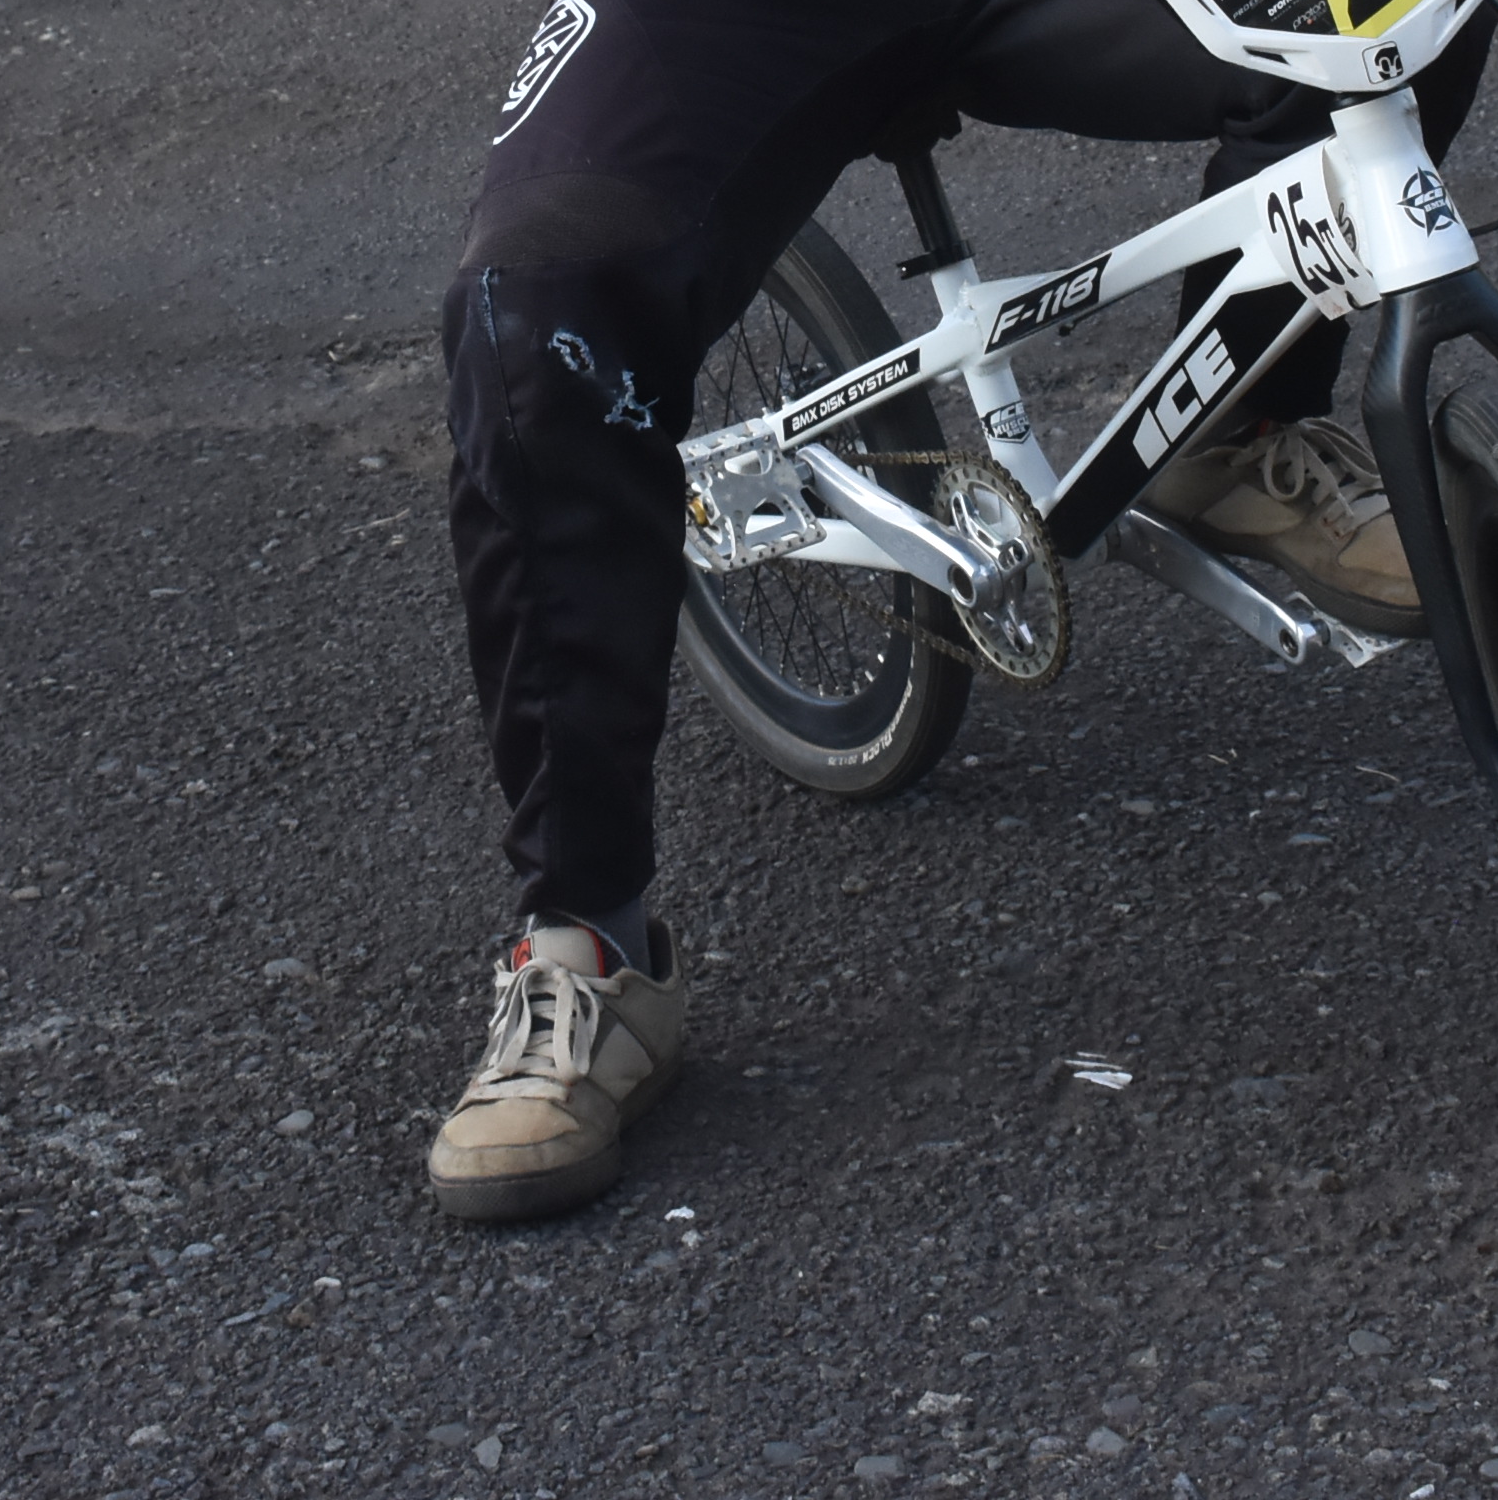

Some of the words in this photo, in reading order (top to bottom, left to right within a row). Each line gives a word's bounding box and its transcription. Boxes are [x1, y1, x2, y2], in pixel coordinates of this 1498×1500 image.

[991, 266, 1100, 344] F-118
[791, 406, 819, 432] BMX
[819, 391, 847, 417] DISK
[847, 359, 909, 402] SYSTEM
[1132, 327, 1237, 470] ICE
